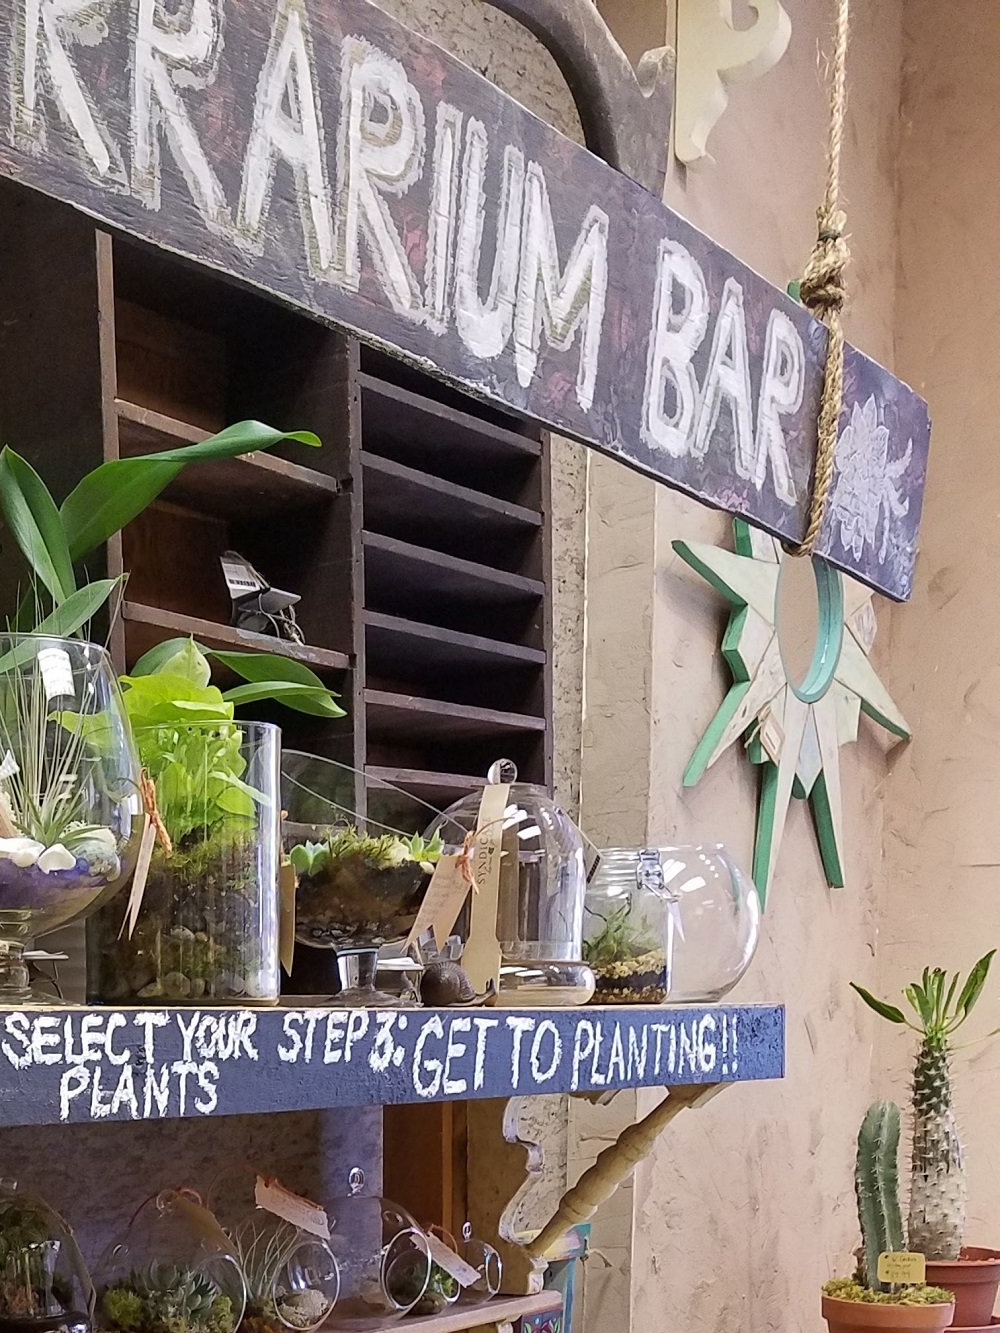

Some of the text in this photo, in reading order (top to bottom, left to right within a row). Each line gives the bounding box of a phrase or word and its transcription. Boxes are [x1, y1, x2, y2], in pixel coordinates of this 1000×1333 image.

[640, 237, 804, 506] BAR
[1, 1009, 260, 1070] SELECT YOUR
[276, 1009, 369, 1065] STEP
[411, 1014, 500, 1098] GET
[505, 1014, 563, 1090] TO
[570, 1012, 740, 1092] PLANTING!!
[57, 1060, 221, 1121] PLANTS
